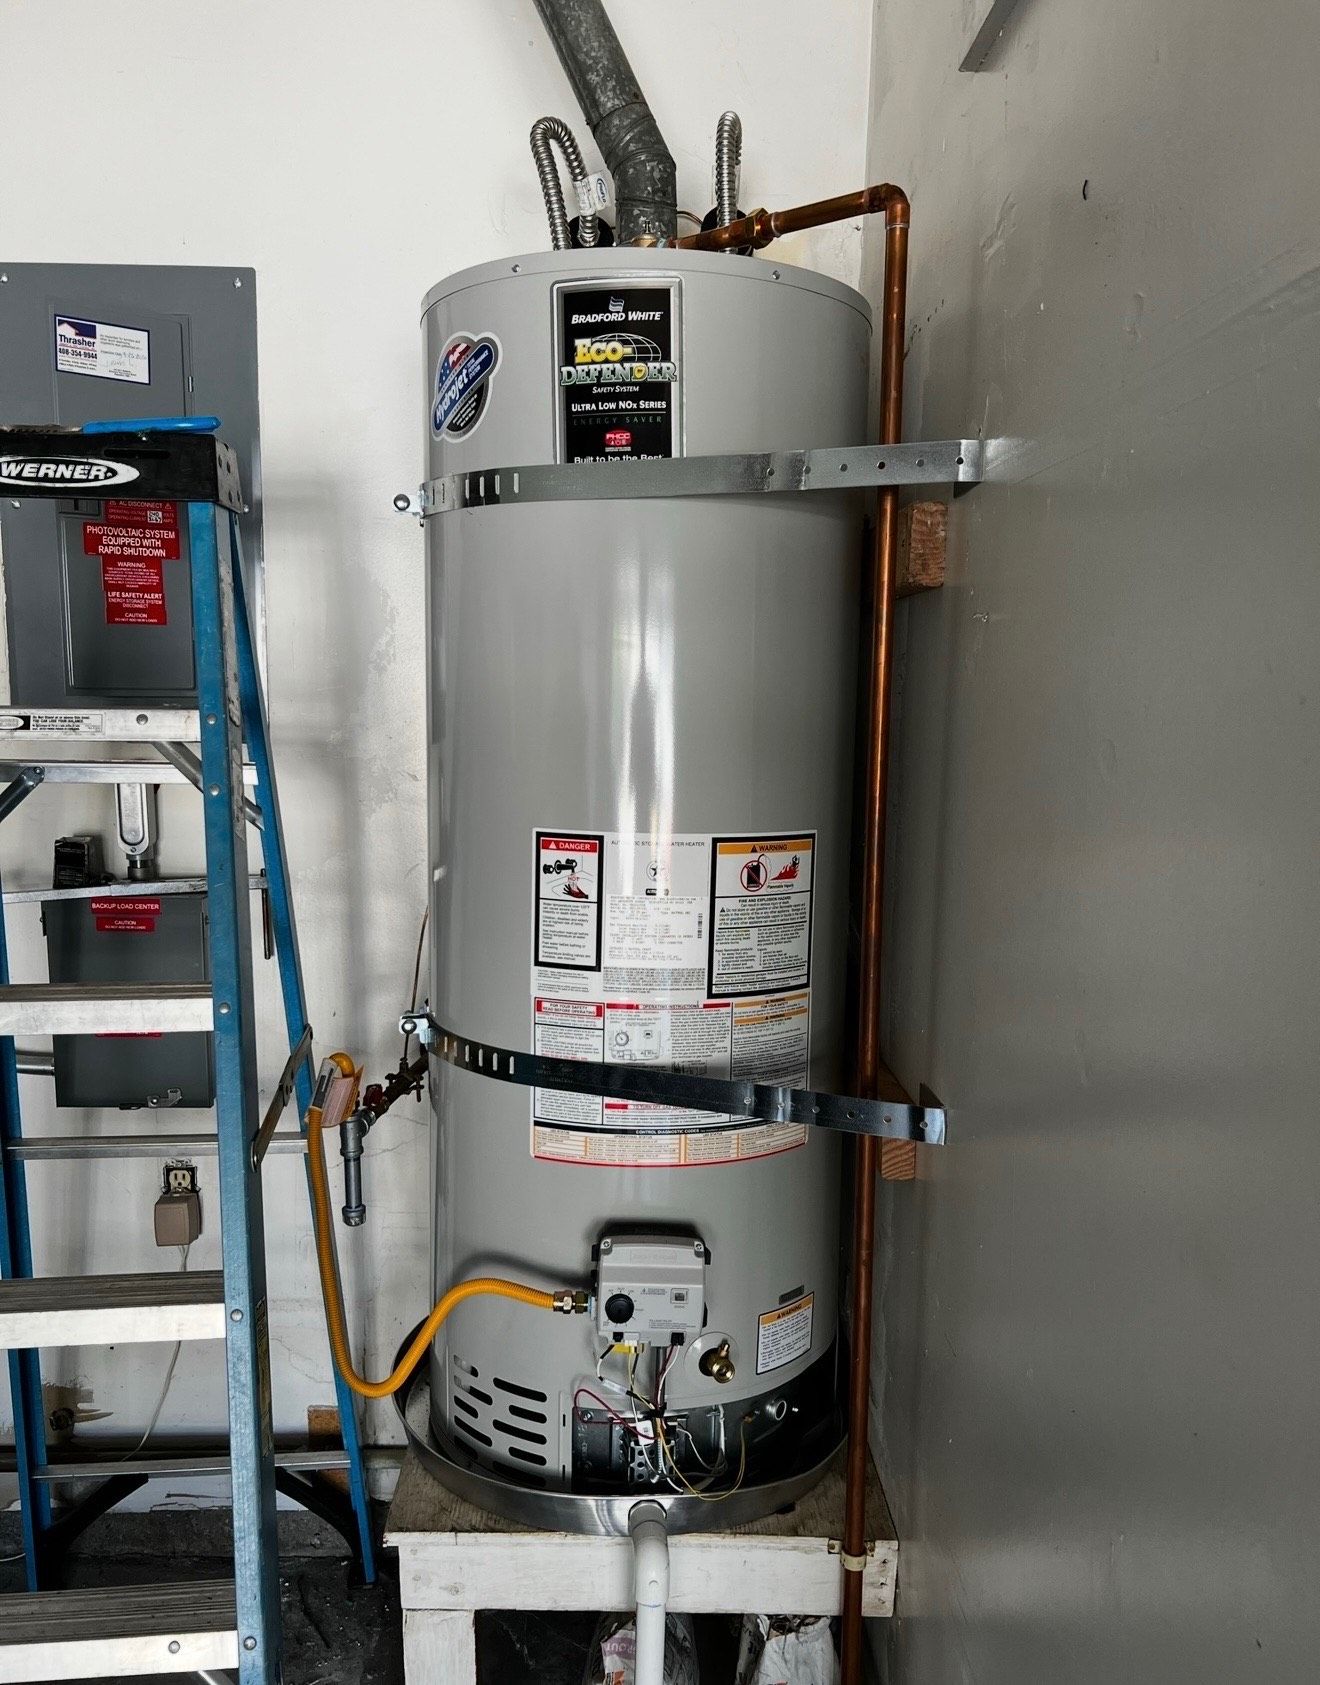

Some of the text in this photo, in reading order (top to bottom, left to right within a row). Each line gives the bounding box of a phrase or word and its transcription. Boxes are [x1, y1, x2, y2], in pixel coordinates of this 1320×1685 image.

[572, 311, 661, 324] BRADFORD WHITE
[59, 334, 95, 347] Thrasher
[561, 362, 677, 386] DEFENDER
[640, 400, 666, 408] SERIES
[2, 462, 107, 479] WERNER
[87, 526, 175, 538] PHOTOVOLTAIC SYSTEM
[103, 536, 161, 547] EQUIPPED WITH
[99, 546, 166, 556] RAPID SHUTDOWN
